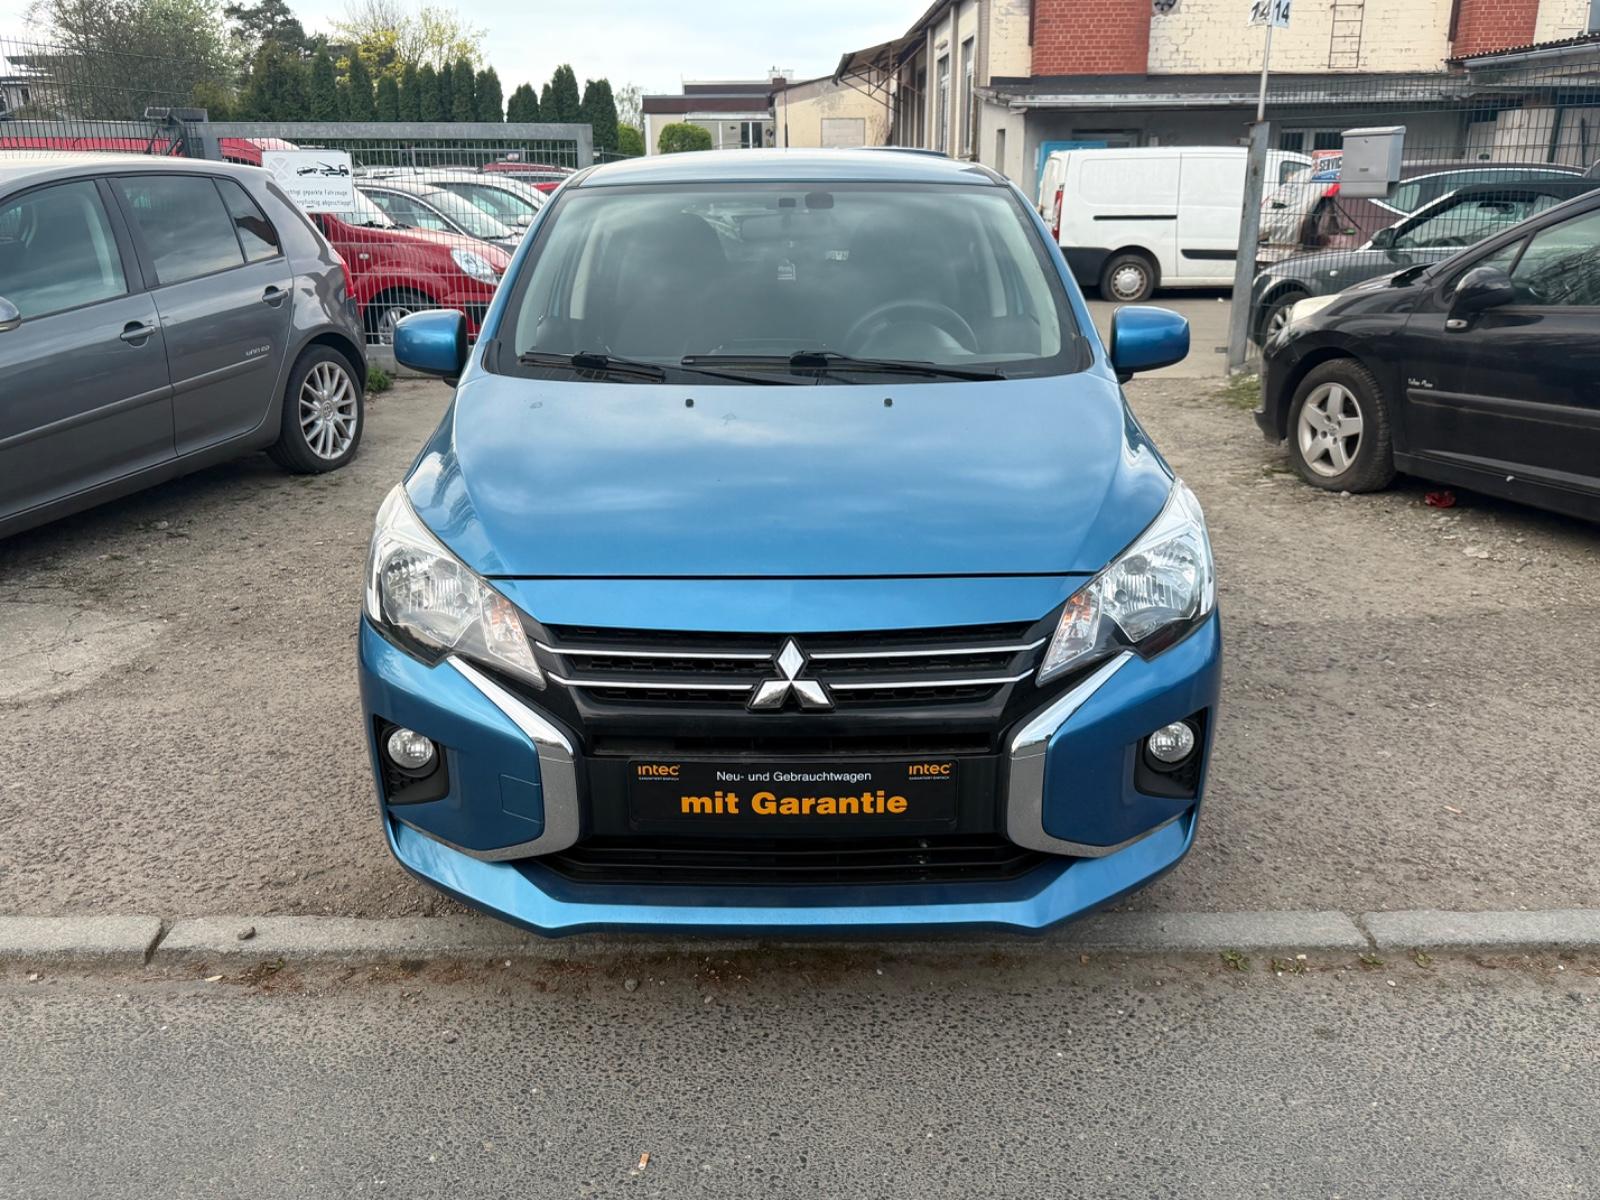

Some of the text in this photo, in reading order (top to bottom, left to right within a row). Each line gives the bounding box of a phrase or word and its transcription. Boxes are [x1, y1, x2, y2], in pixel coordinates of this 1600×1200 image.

[1275, 0, 1290, 23] 14
[1319, 157, 1343, 172] SERVIC
[716, 771, 872, 784] Neu- und Gebrauchtwagen
[680, 790, 908, 816] mit Garantie
